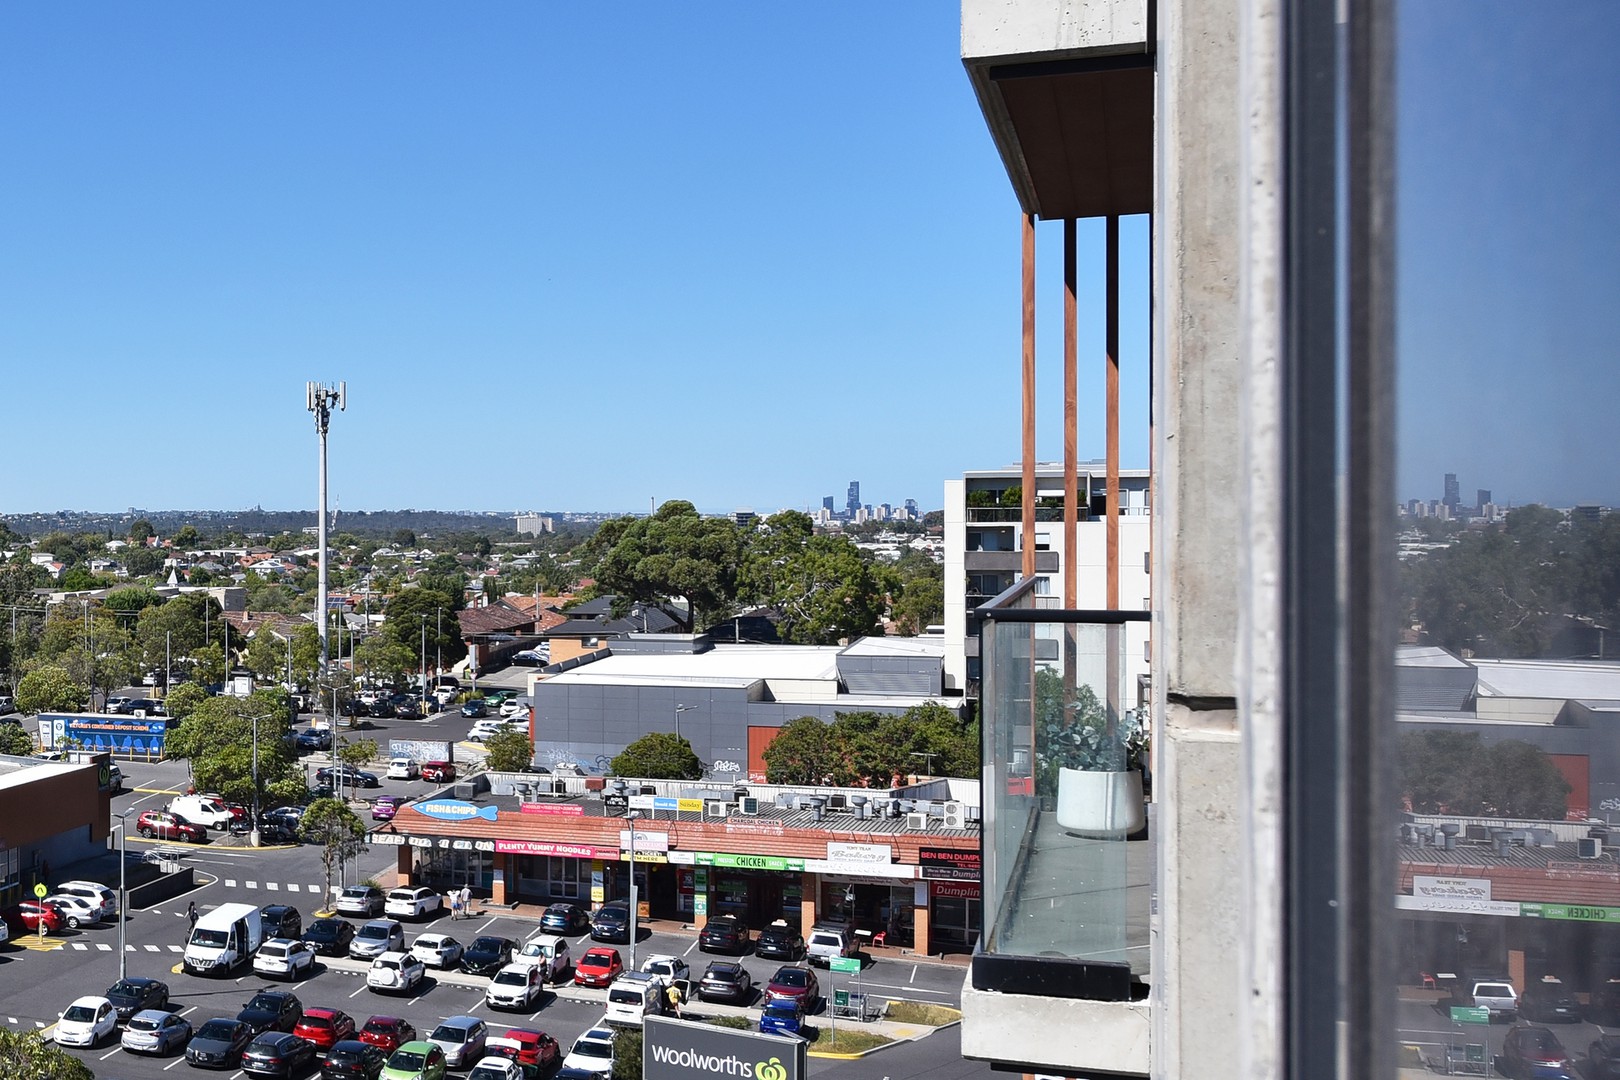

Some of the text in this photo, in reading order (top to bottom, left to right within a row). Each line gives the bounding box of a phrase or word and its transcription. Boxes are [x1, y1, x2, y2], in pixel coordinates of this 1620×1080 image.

[426, 804, 478, 815] FISH&CHIPS
[499, 842, 525, 850] PLENTY
[527, 843, 555, 852] YUMMY
[556, 845, 592, 856] NOODLES
[736, 856, 767, 868] CHICKEN
[831, 850, 886, 862] Bakery
[938, 852, 953, 860] BEN
[651, 1044, 753, 1078] Woolworths
